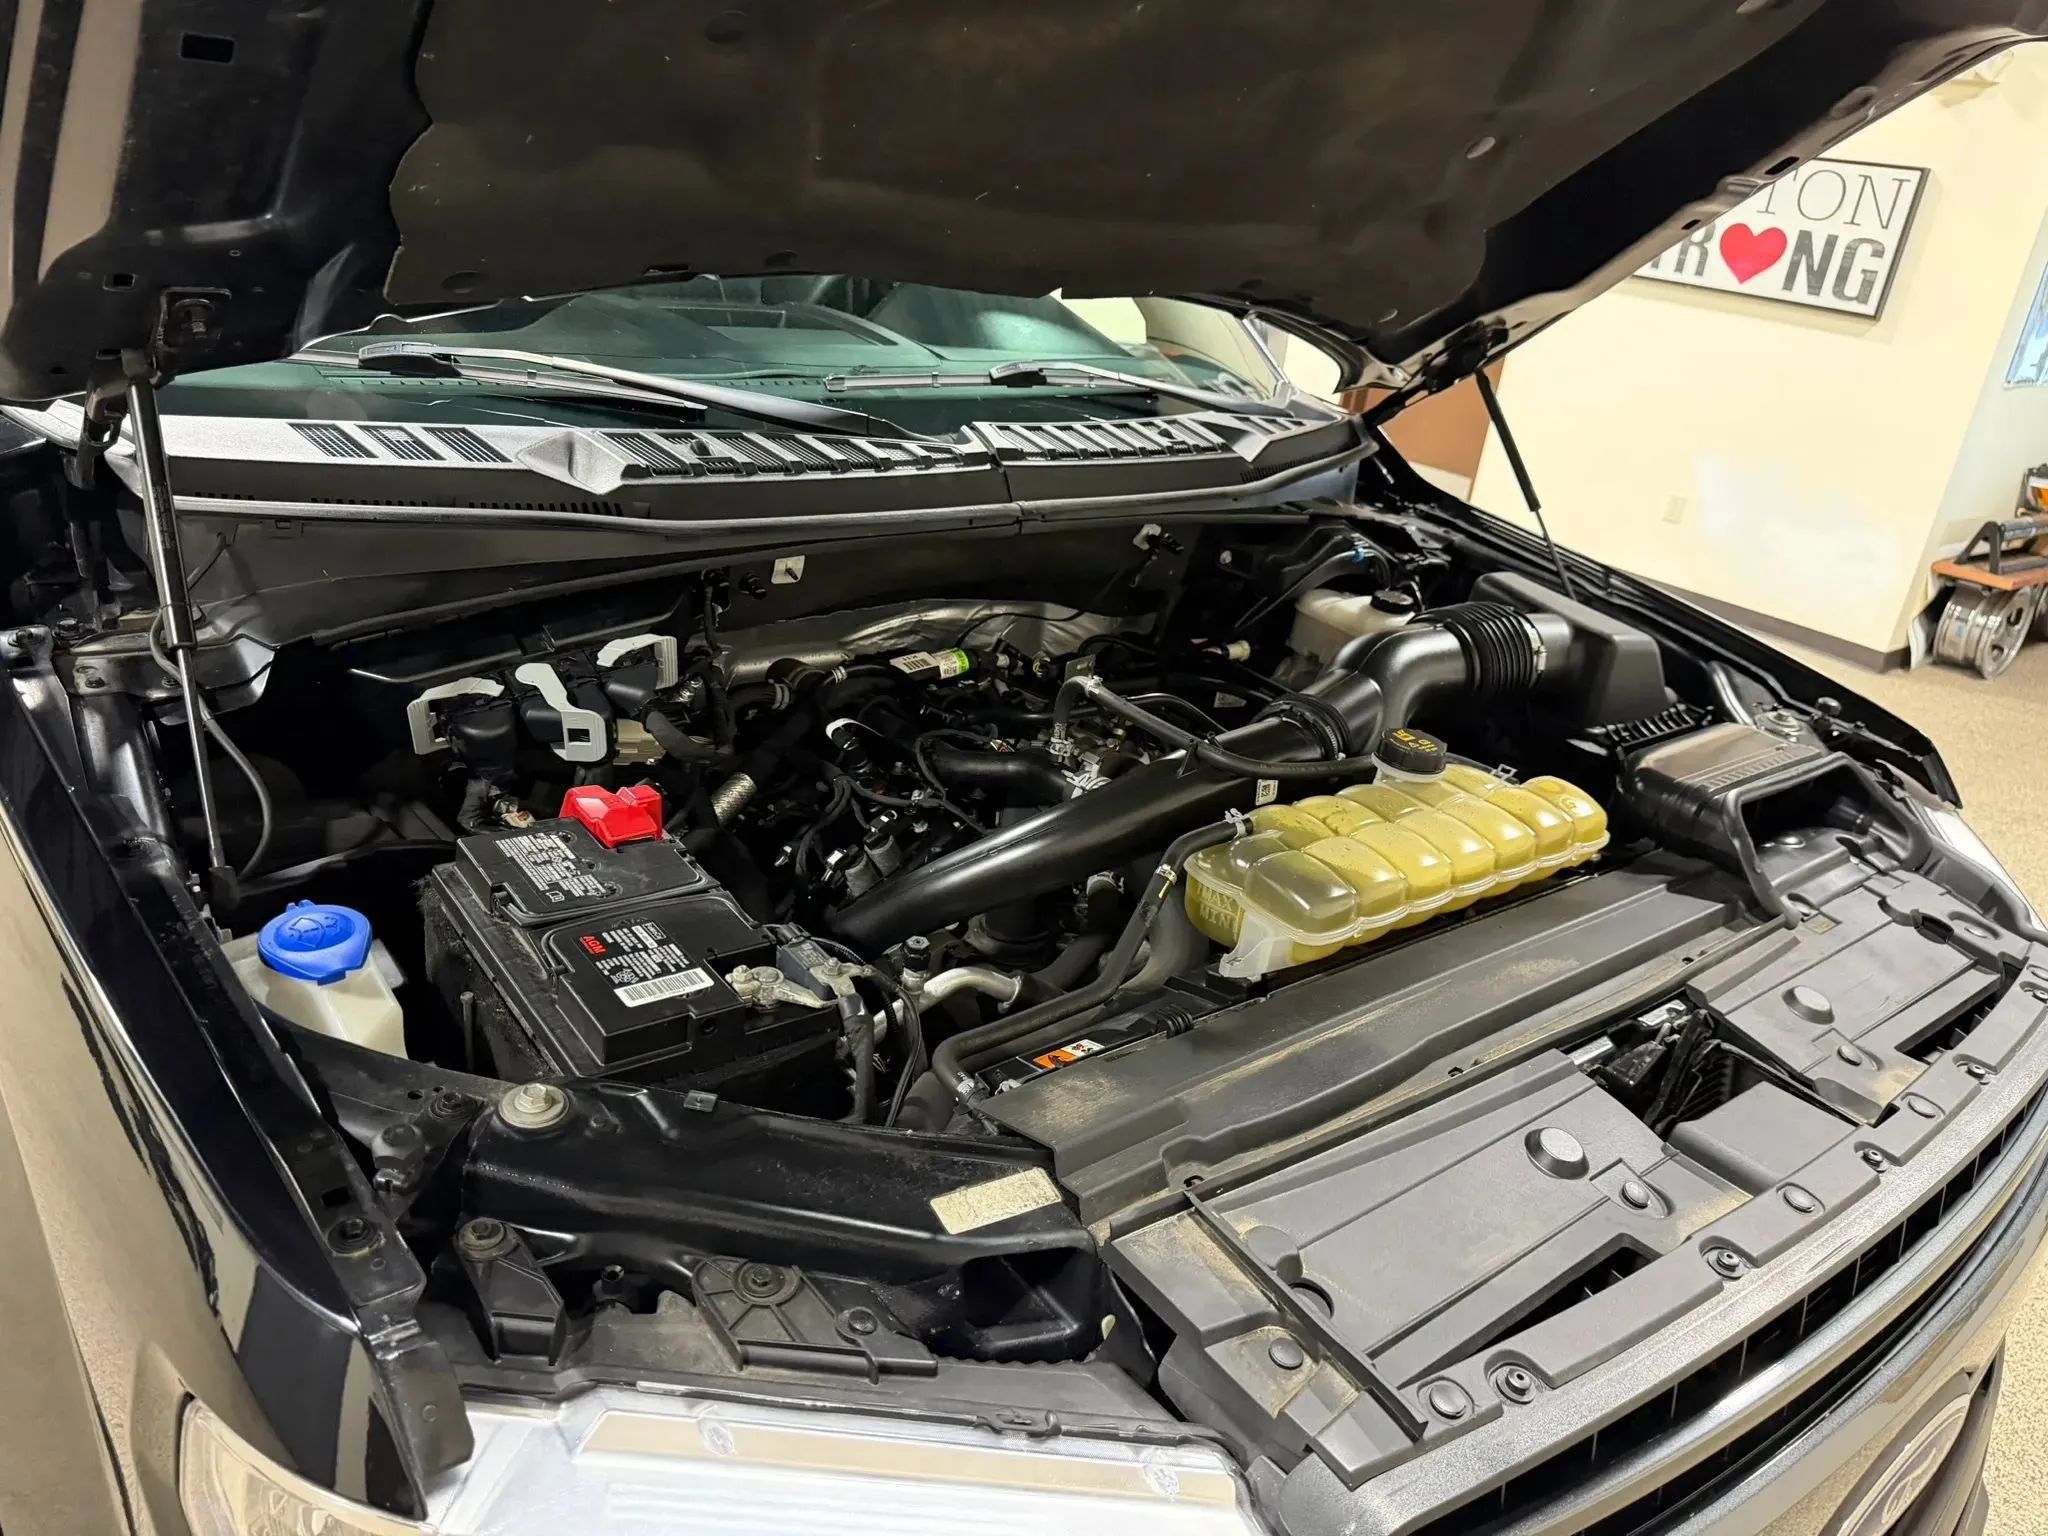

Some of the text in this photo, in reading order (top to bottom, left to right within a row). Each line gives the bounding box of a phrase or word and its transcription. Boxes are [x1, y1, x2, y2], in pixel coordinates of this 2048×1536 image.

[1201, 884, 1233, 912] MAX
[1200, 903, 1231, 928] MIN
[582, 935, 608, 955] AGM
